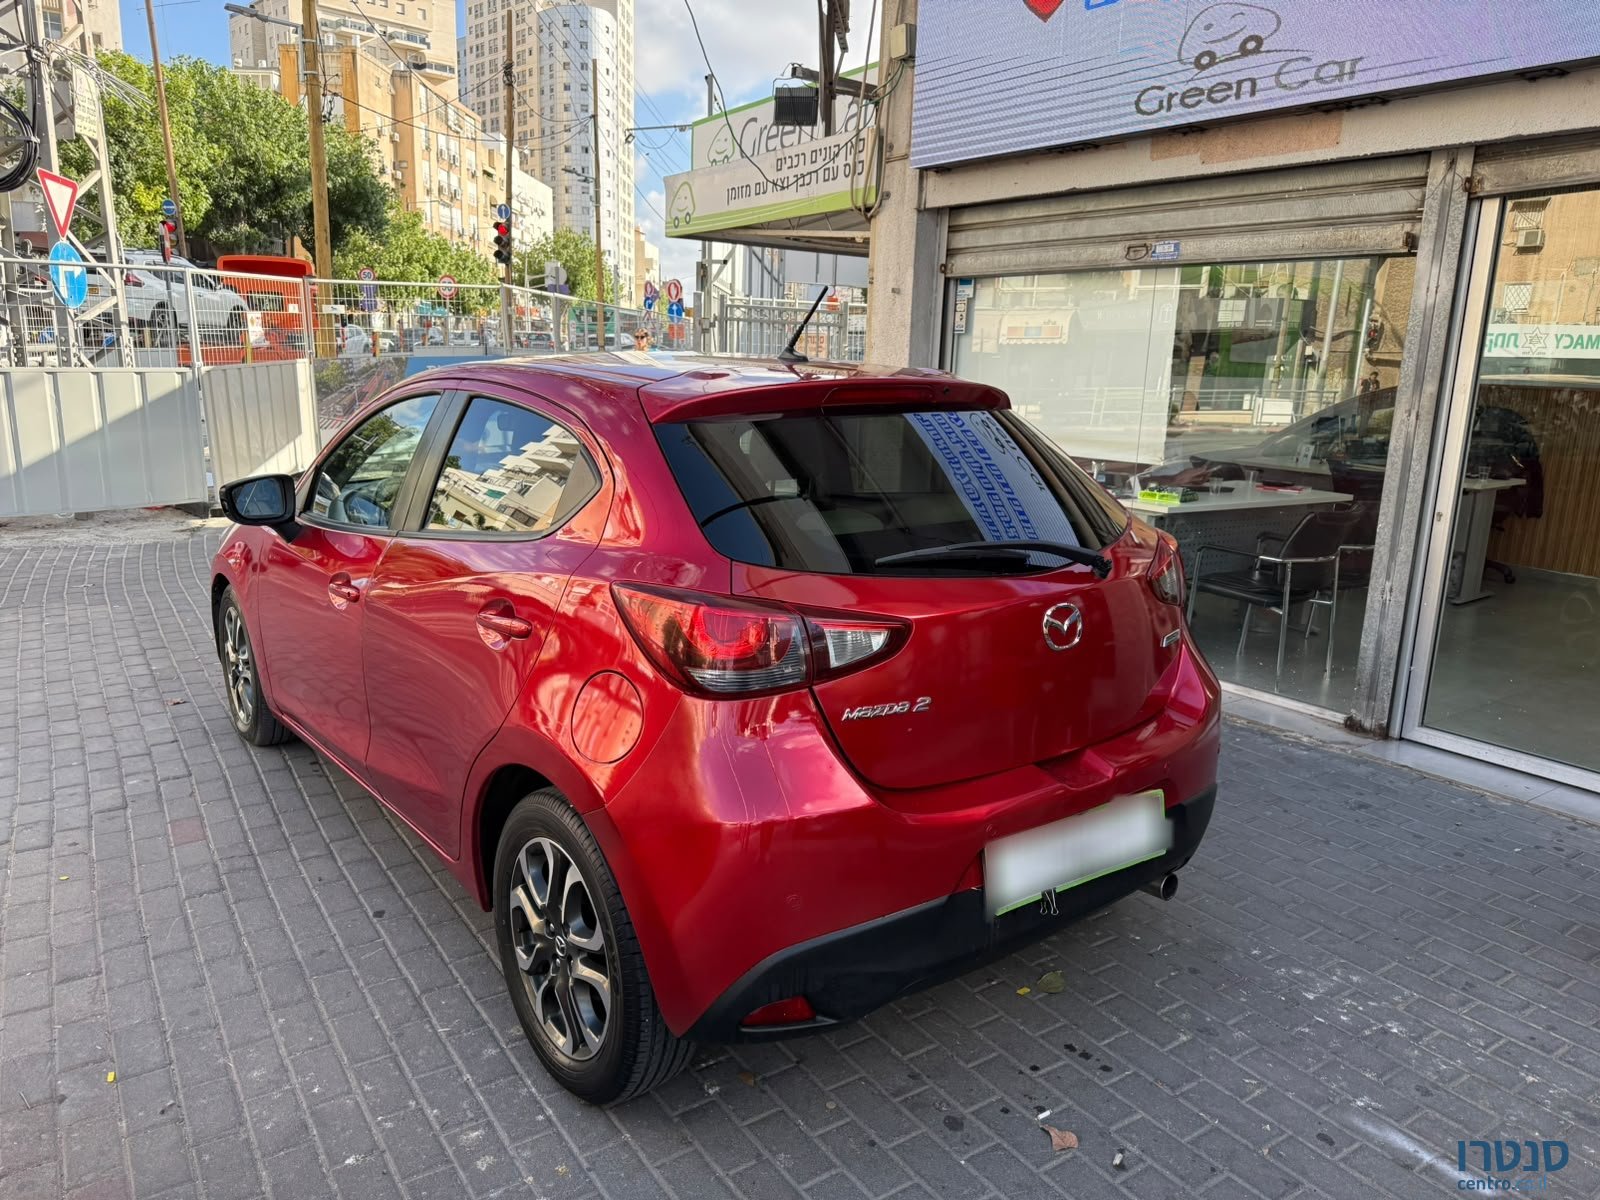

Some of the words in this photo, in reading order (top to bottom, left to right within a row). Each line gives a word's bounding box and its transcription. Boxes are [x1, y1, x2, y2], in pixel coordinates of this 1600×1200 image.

[1134, 77, 1257, 116] Green
[1274, 56, 1365, 91] Car
[775, 151, 807, 173] רכבים
[810, 143, 841, 164] קונים
[822, 165, 840, 183] עם
[843, 159, 865, 178] כס
[754, 180, 769, 196] עם
[793, 170, 819, 193] רכבך
[726, 183, 752, 206] מזומן
[912, 696, 932, 713] 2
